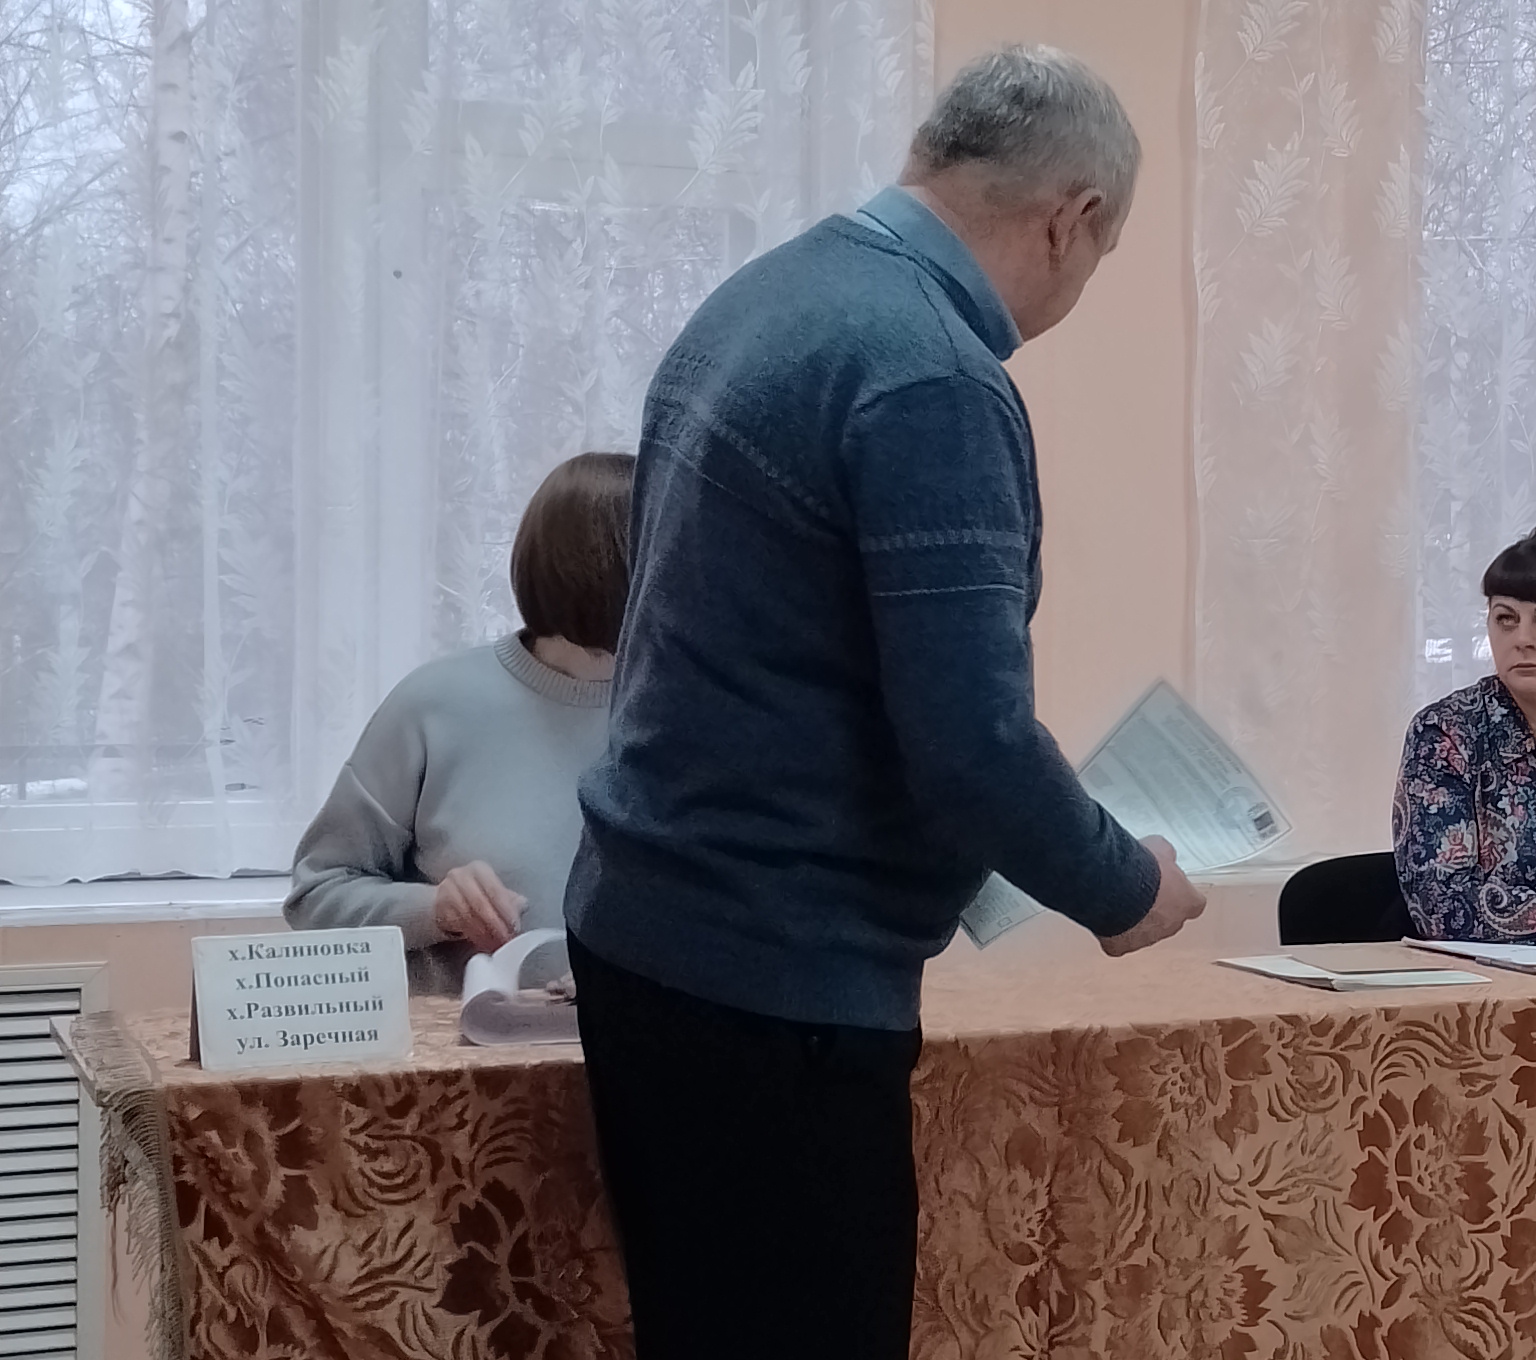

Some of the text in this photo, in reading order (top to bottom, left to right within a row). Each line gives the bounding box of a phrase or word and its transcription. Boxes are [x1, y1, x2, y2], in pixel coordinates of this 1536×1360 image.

[228, 940, 372, 962] х.Калиновка
[235, 966, 370, 991] х.Попасный
[226, 995, 384, 1021] х.Развильный
[236, 1028, 379, 1055] ул. Заречная
